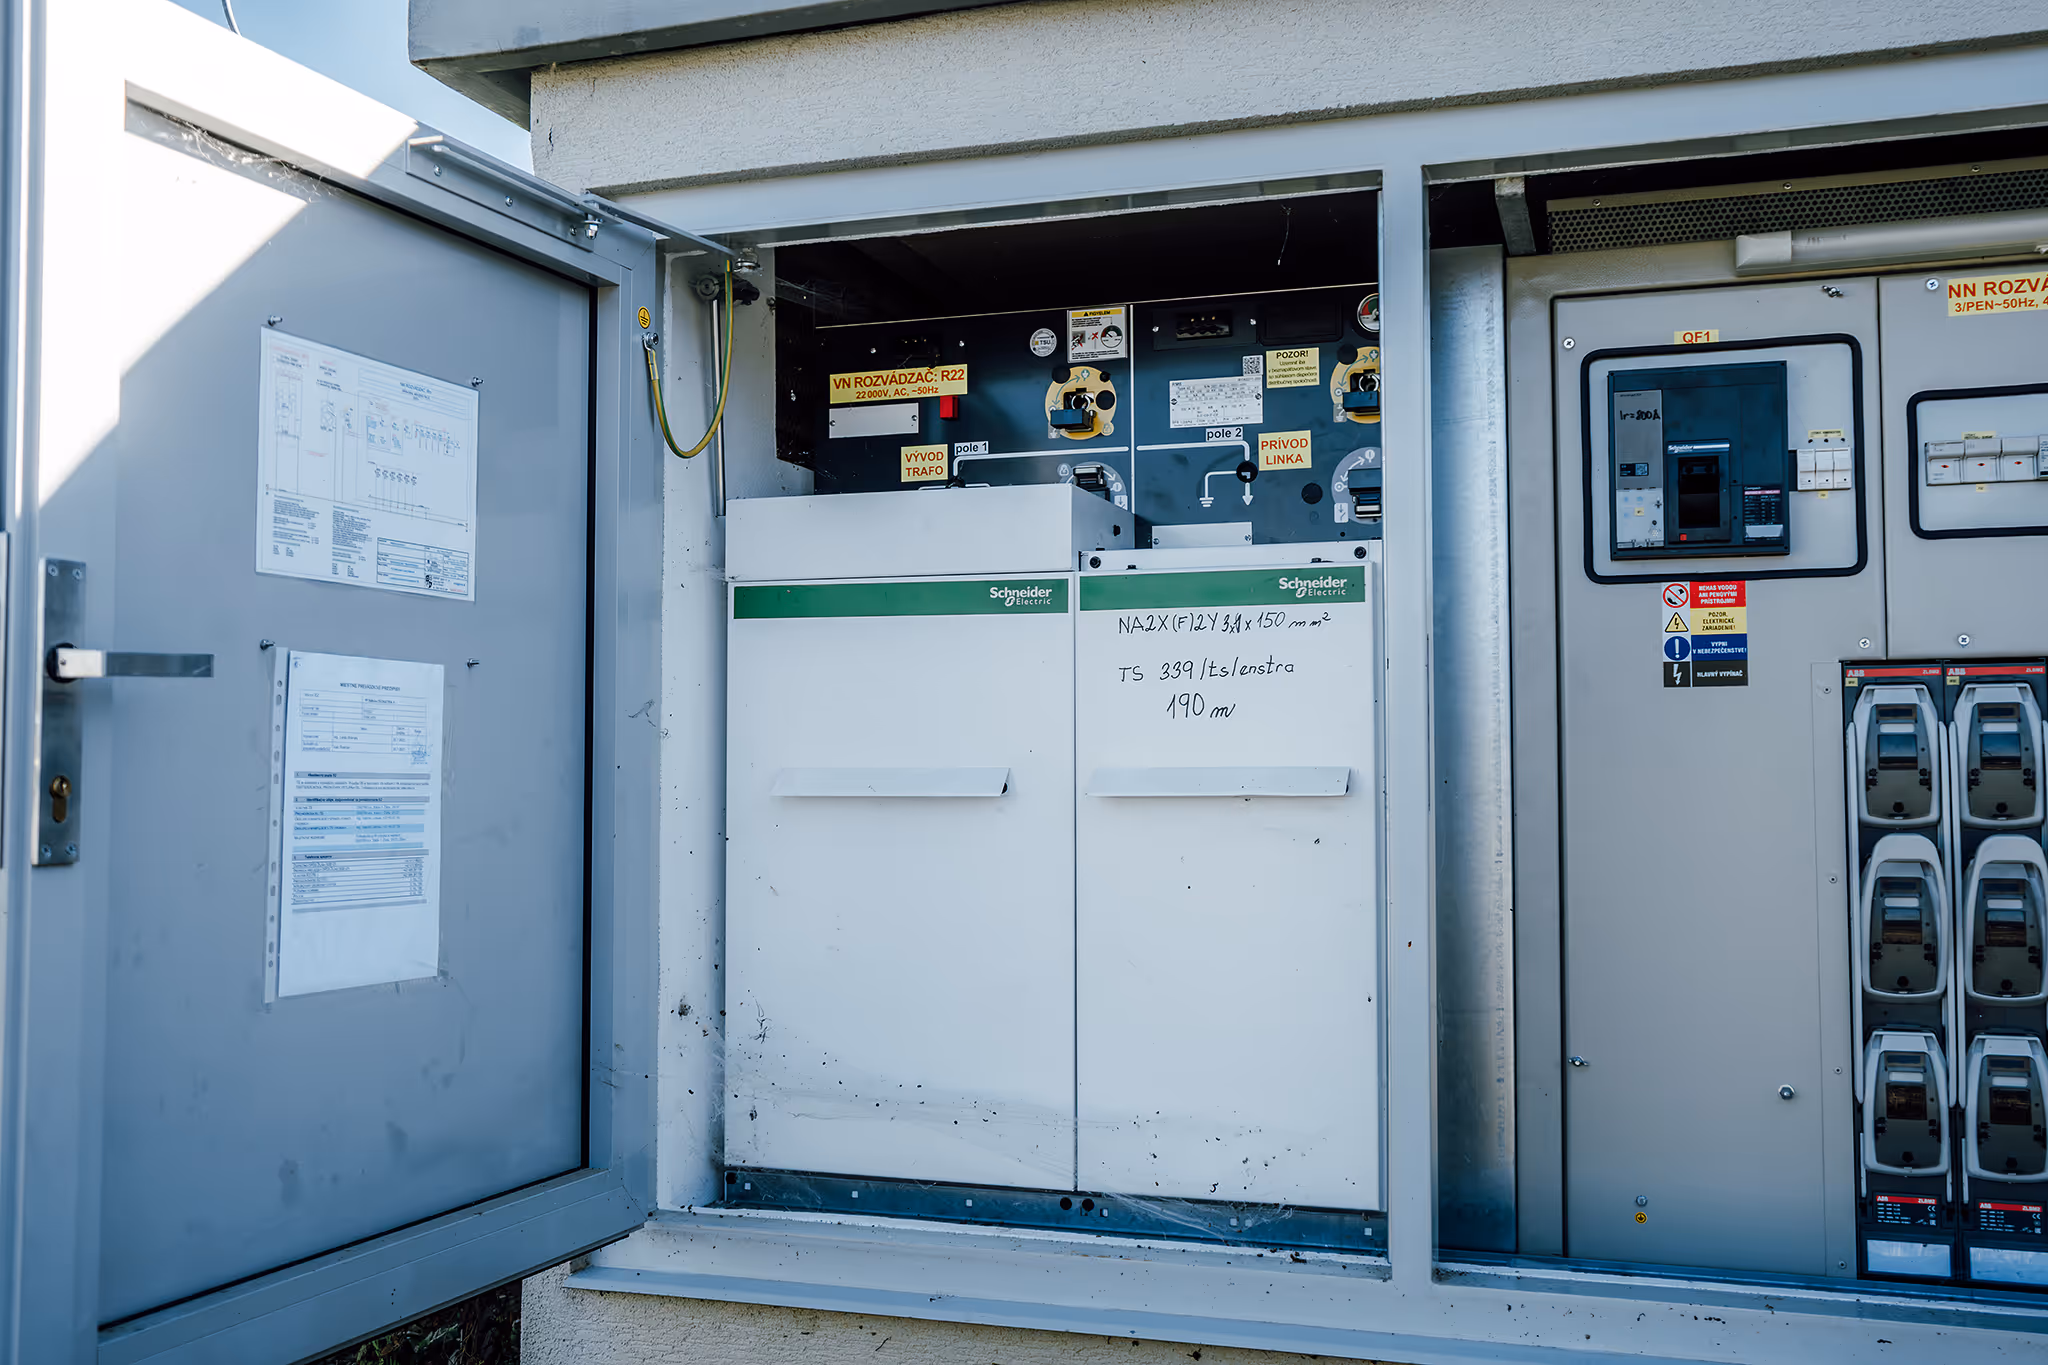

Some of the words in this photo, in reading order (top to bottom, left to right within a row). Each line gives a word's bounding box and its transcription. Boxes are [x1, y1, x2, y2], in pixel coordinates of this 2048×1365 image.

[1948, 283, 1976, 299] NN
[1955, 298, 2039, 313] 3/PEN~50Hz,
[1682, 330, 1710, 344] QF1
[1276, 350, 1309, 359] POZOR!
[833, 377, 851, 390] VN
[854, 368, 938, 388] ROZVÁDZAČ:
[941, 368, 965, 382] R22
[893, 387, 910, 397] AC,
[912, 386, 939, 395] ~50Hz
[1206, 428, 1232, 441] pole
[1235, 427, 1242, 438] 2
[955, 443, 979, 454] pole
[982, 442, 988, 452] 1
[1261, 436, 1308, 450] PRÍVOD
[905, 450, 944, 463] VÝVOD
[1265, 453, 1304, 465] LINKA
[905, 465, 944, 477] TRAFO
[1278, 576, 1347, 590] Schneider
[989, 586, 1052, 599] Schneider
[1308, 588, 1346, 598] Electric
[1016, 598, 1051, 606] Electric
[1119, 665, 1144, 682] TS
[1848, 669, 1865, 677] ABB
[1948, 668, 1966, 676] ABB
[1166, 692, 1205, 719] 190
[1210, 703, 1236, 718] m
